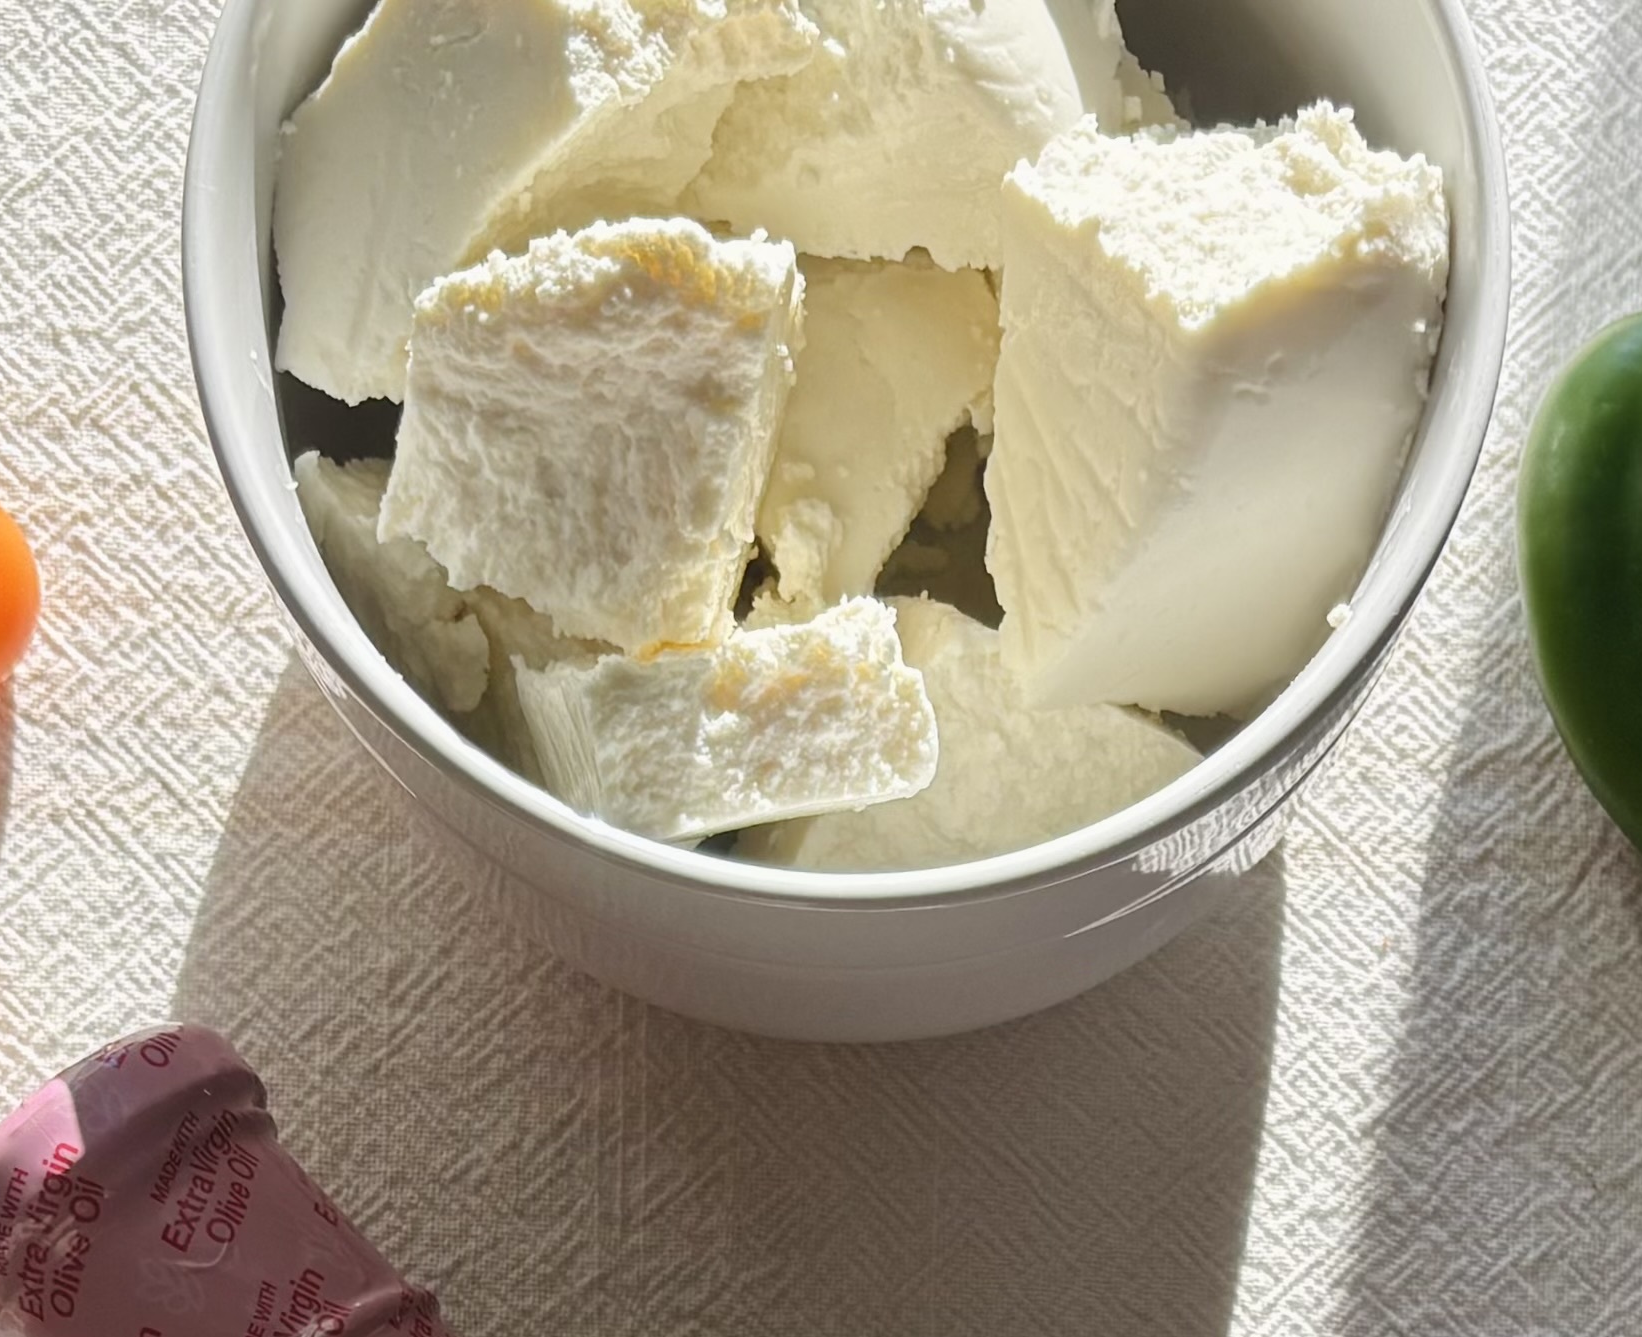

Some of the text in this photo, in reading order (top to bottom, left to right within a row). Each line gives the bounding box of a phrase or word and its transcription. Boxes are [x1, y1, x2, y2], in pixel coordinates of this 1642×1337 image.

[0, 1168, 29, 1217] WITH
[150, 1111, 200, 1205] MADE WITH
[161, 1109, 239, 1253] Extra Virgin
[206, 1143, 260, 1246] Olive Oil
[20, 1237, 49, 1322] Extra
[50, 1176, 105, 1319] Olive Oil
[254, 1281, 278, 1325] WITH
[319, 1301, 353, 1336] Oil
